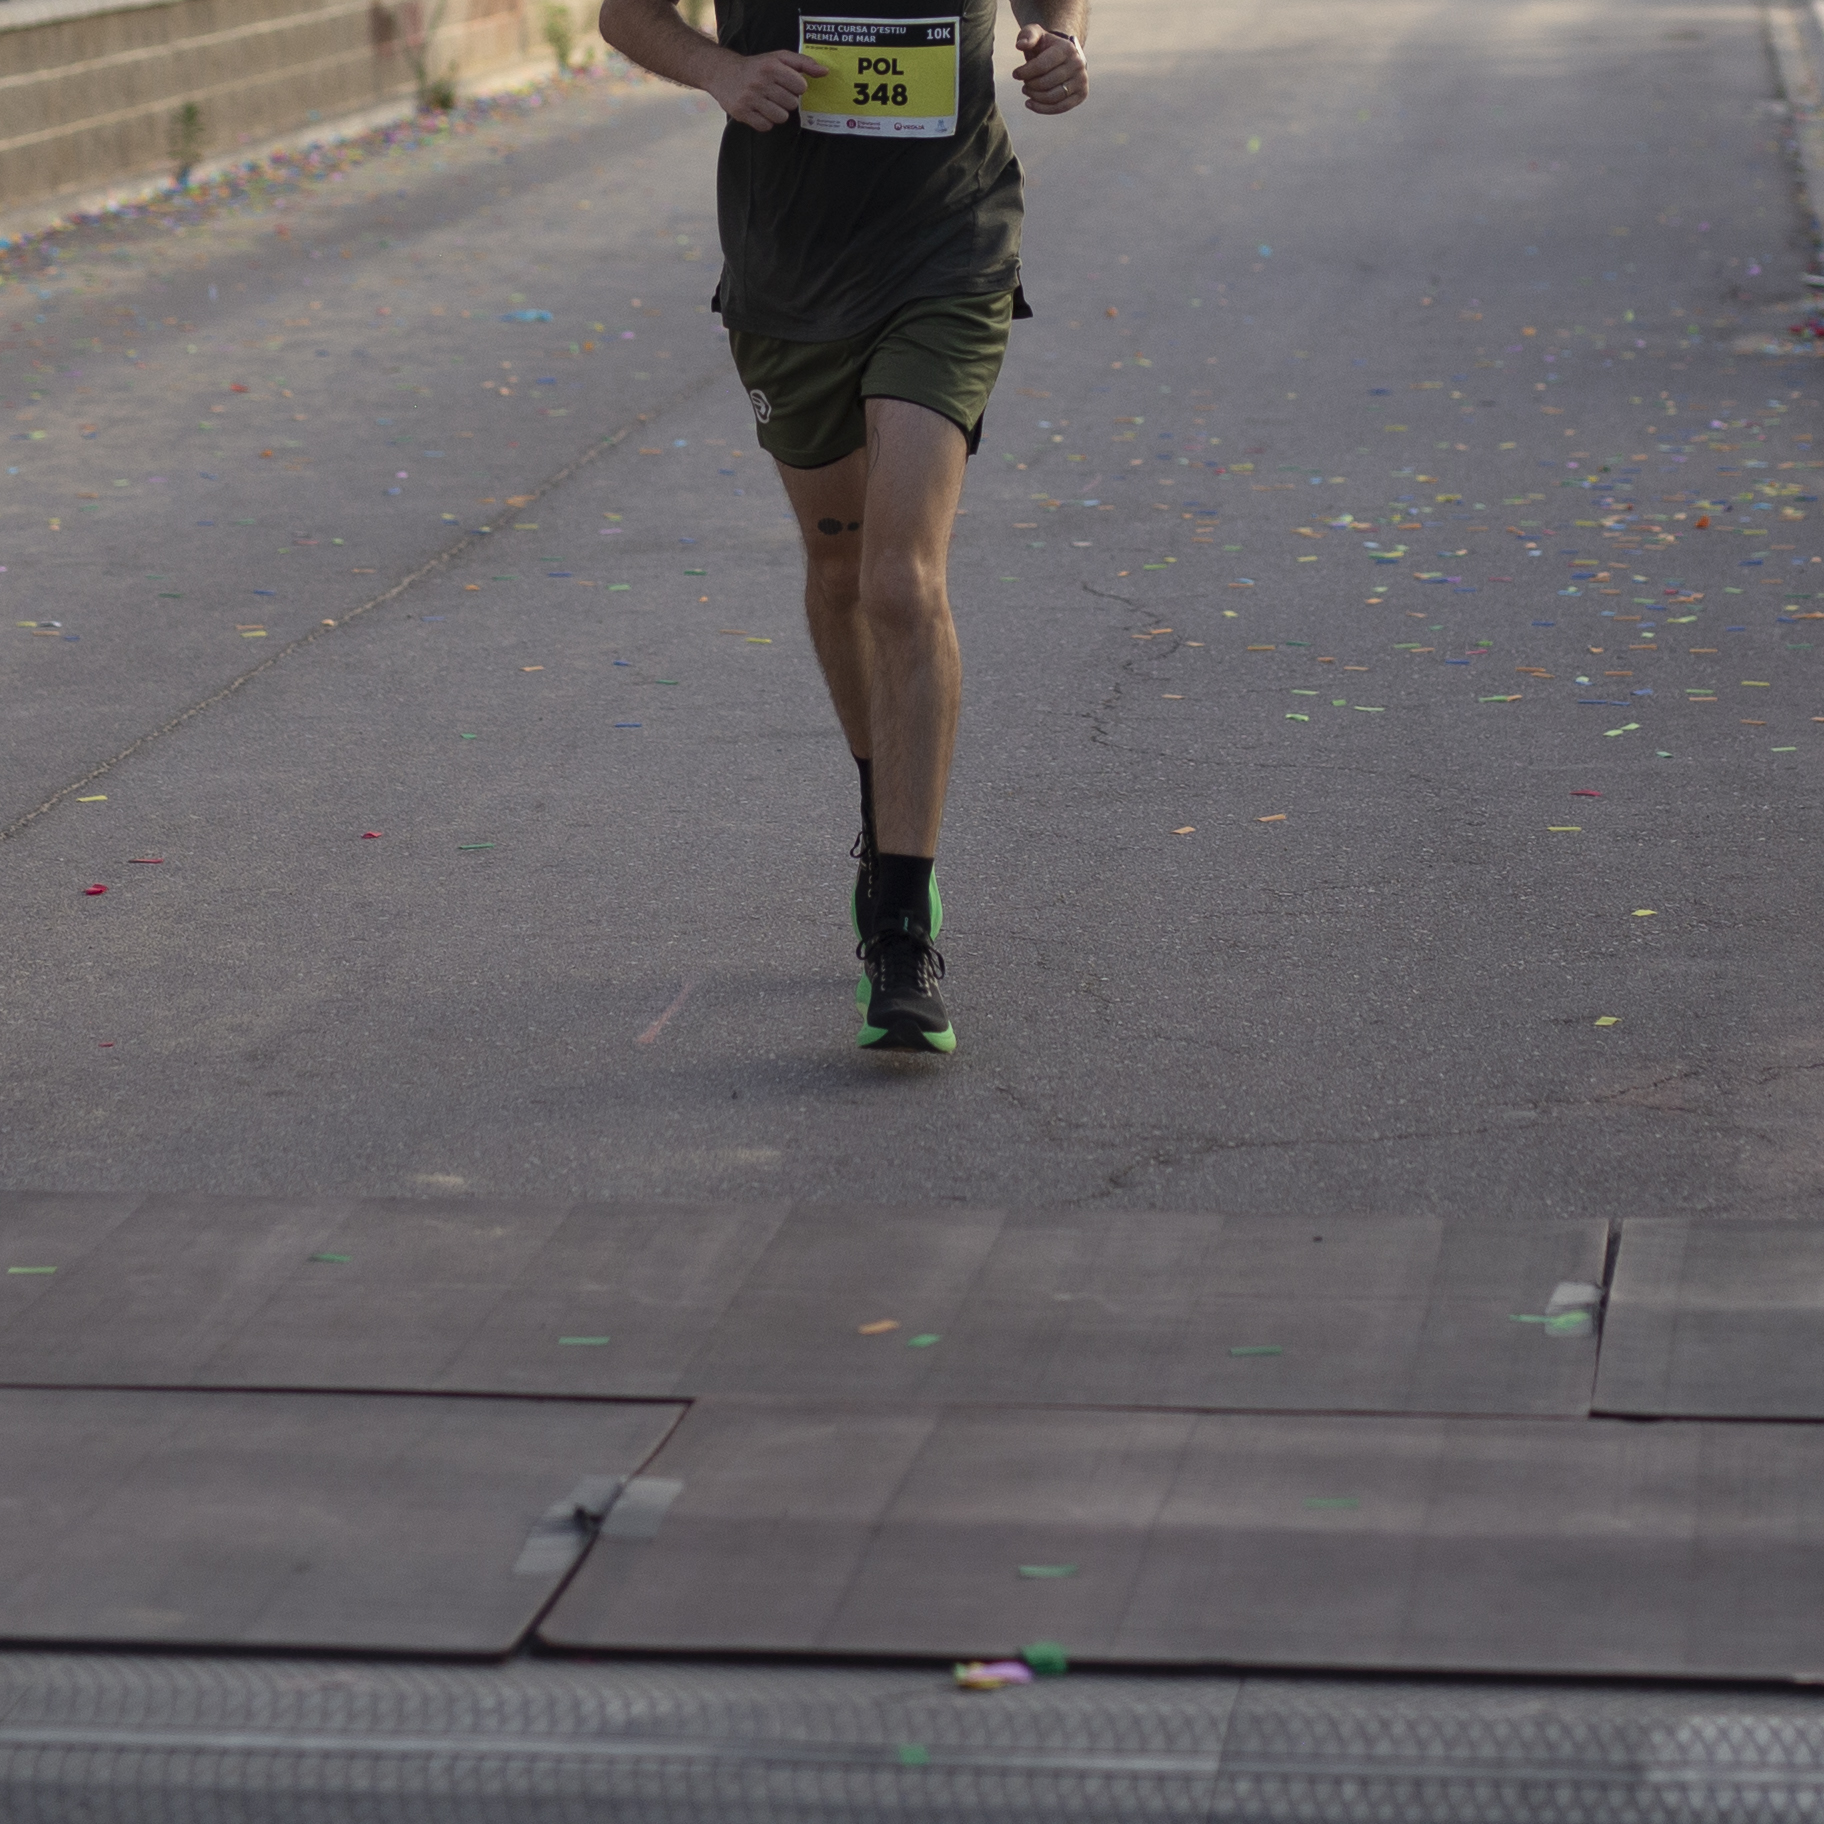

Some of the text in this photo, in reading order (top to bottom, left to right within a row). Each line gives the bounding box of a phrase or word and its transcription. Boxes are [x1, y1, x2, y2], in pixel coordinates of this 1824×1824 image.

[805, 23, 835, 32] XXVIII
[837, 25, 868, 33] CURSA
[926, 27, 951, 40] 10K
[805, 32, 876, 43] PREMIÀ DE MAR
[857, 57, 904, 76] POL
[852, 83, 908, 106] 348
